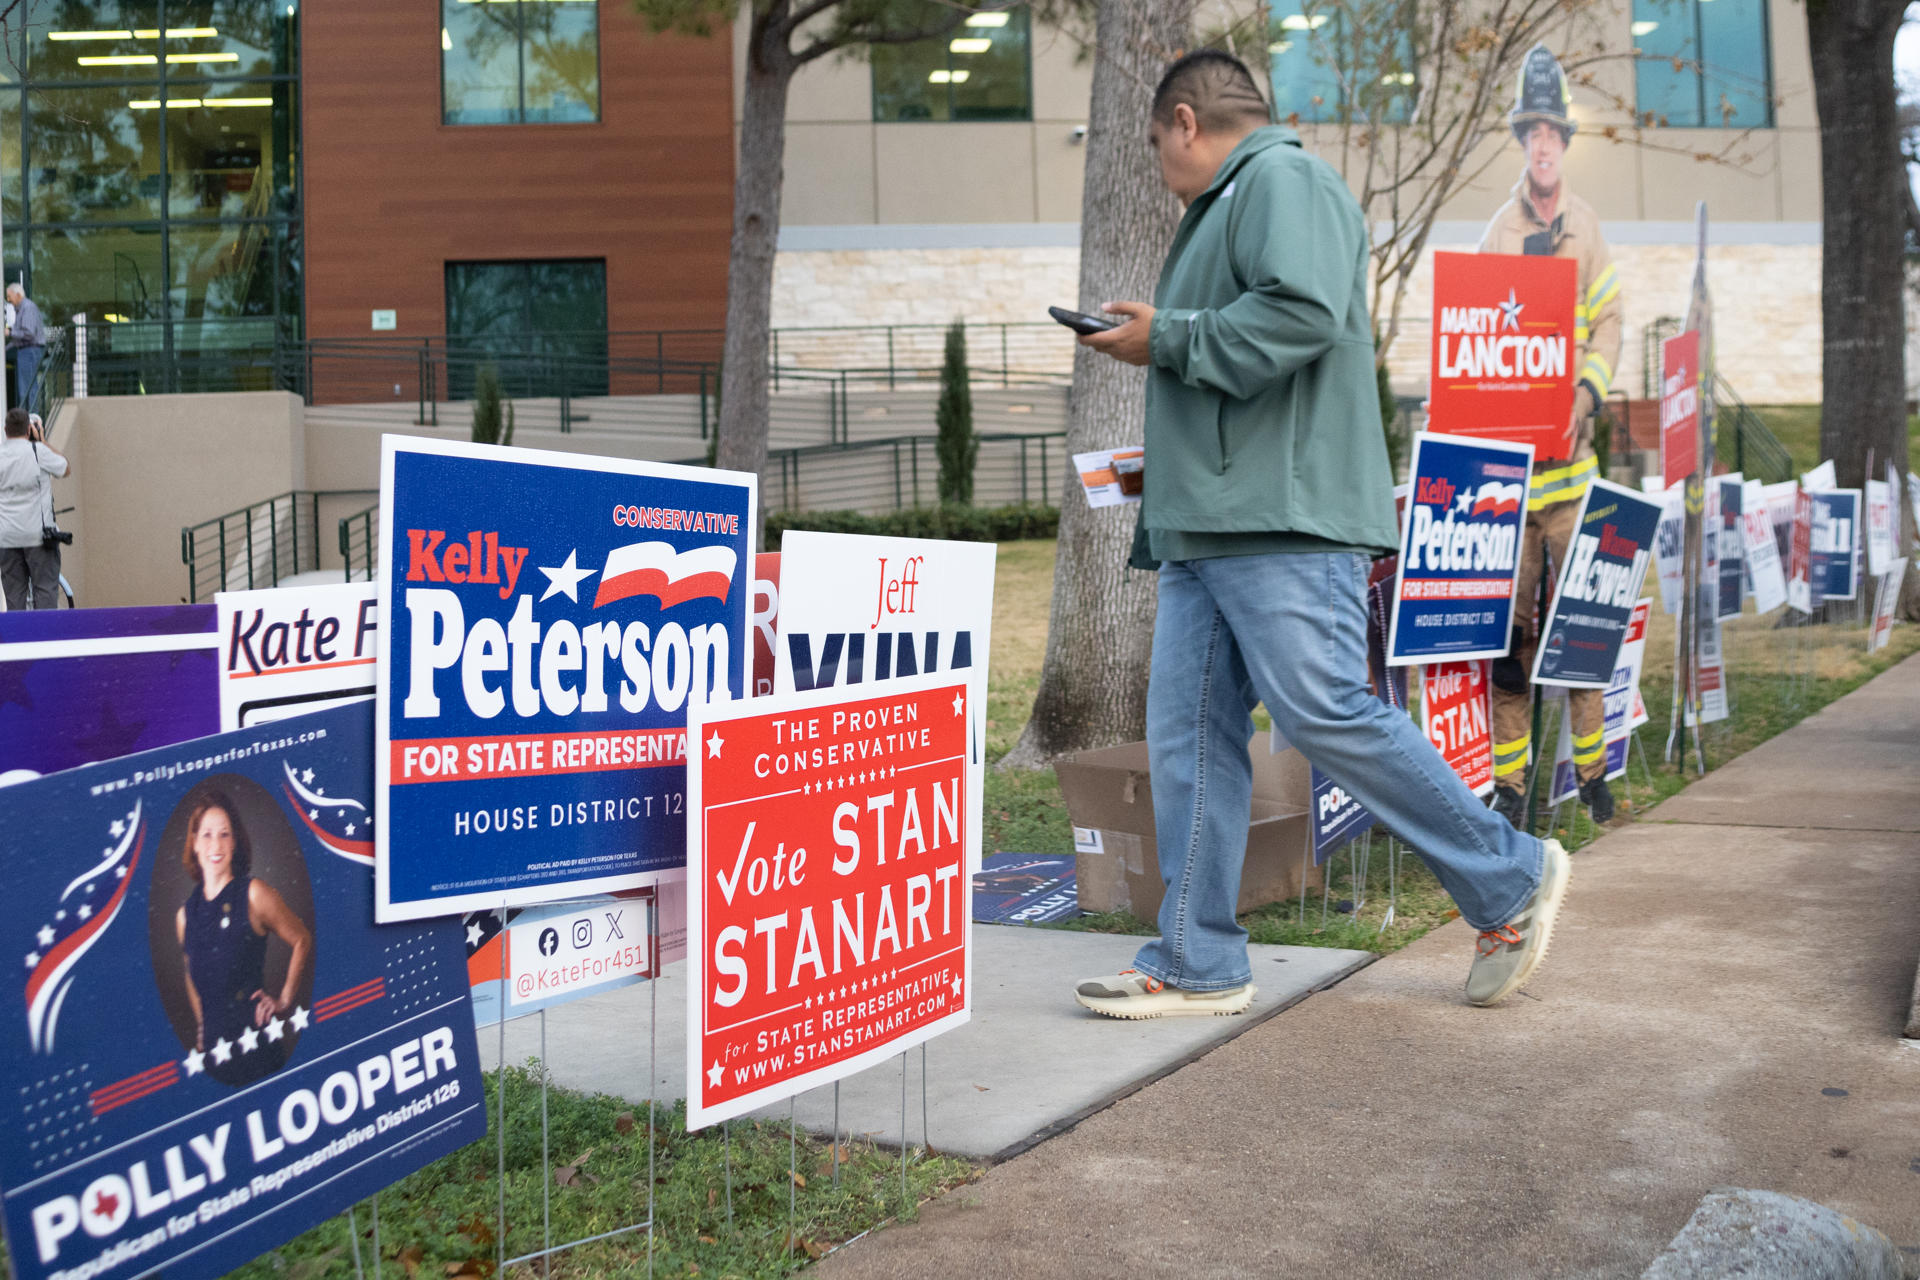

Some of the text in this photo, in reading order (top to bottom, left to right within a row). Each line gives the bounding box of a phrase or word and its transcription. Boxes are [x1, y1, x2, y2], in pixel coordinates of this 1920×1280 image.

[1440, 307, 1500, 334] MARTY
[1438, 335, 1566, 378] LANCTON
[613, 505, 739, 535] CONSERVATIVE
[1416, 477, 1456, 512] Kelly
[406, 529, 529, 600] Kelly
[1406, 505, 1516, 571] Peterson
[1561, 533, 1649, 609] Howell
[871, 555, 923, 629] Jeff
[1403, 581, 1422, 597] FOR
[1423, 581, 1449, 597] STATE
[228, 608, 340, 675] Kate
[404, 588, 732, 718] Peterson
[404, 733, 687, 777] FOR STATE REPRESENTA
[754, 728, 931, 778] CONSERVATIVE
[772, 703, 918, 745] THE PROVEN
[90, 728, 328, 797] www.PollyLooperforTexas.com
[455, 793, 683, 836] HOUSE DISTRICT 12
[832, 777, 960, 876] STAN
[1319, 786, 1353, 821] POL
[713, 860, 959, 1008] STANART
[516, 945, 645, 998] @KateFor451
[725, 968, 950, 1063] for STATE REPRESENTATIVE
[31, 1026, 458, 1265] POLLY LOOPER
[166, 1209, 198, 1239] for
[197, 1185, 252, 1224] State
[250, 1121, 377, 1199] Representative
[376, 1097, 433, 1134] District
[433, 1079, 461, 1106] 126
